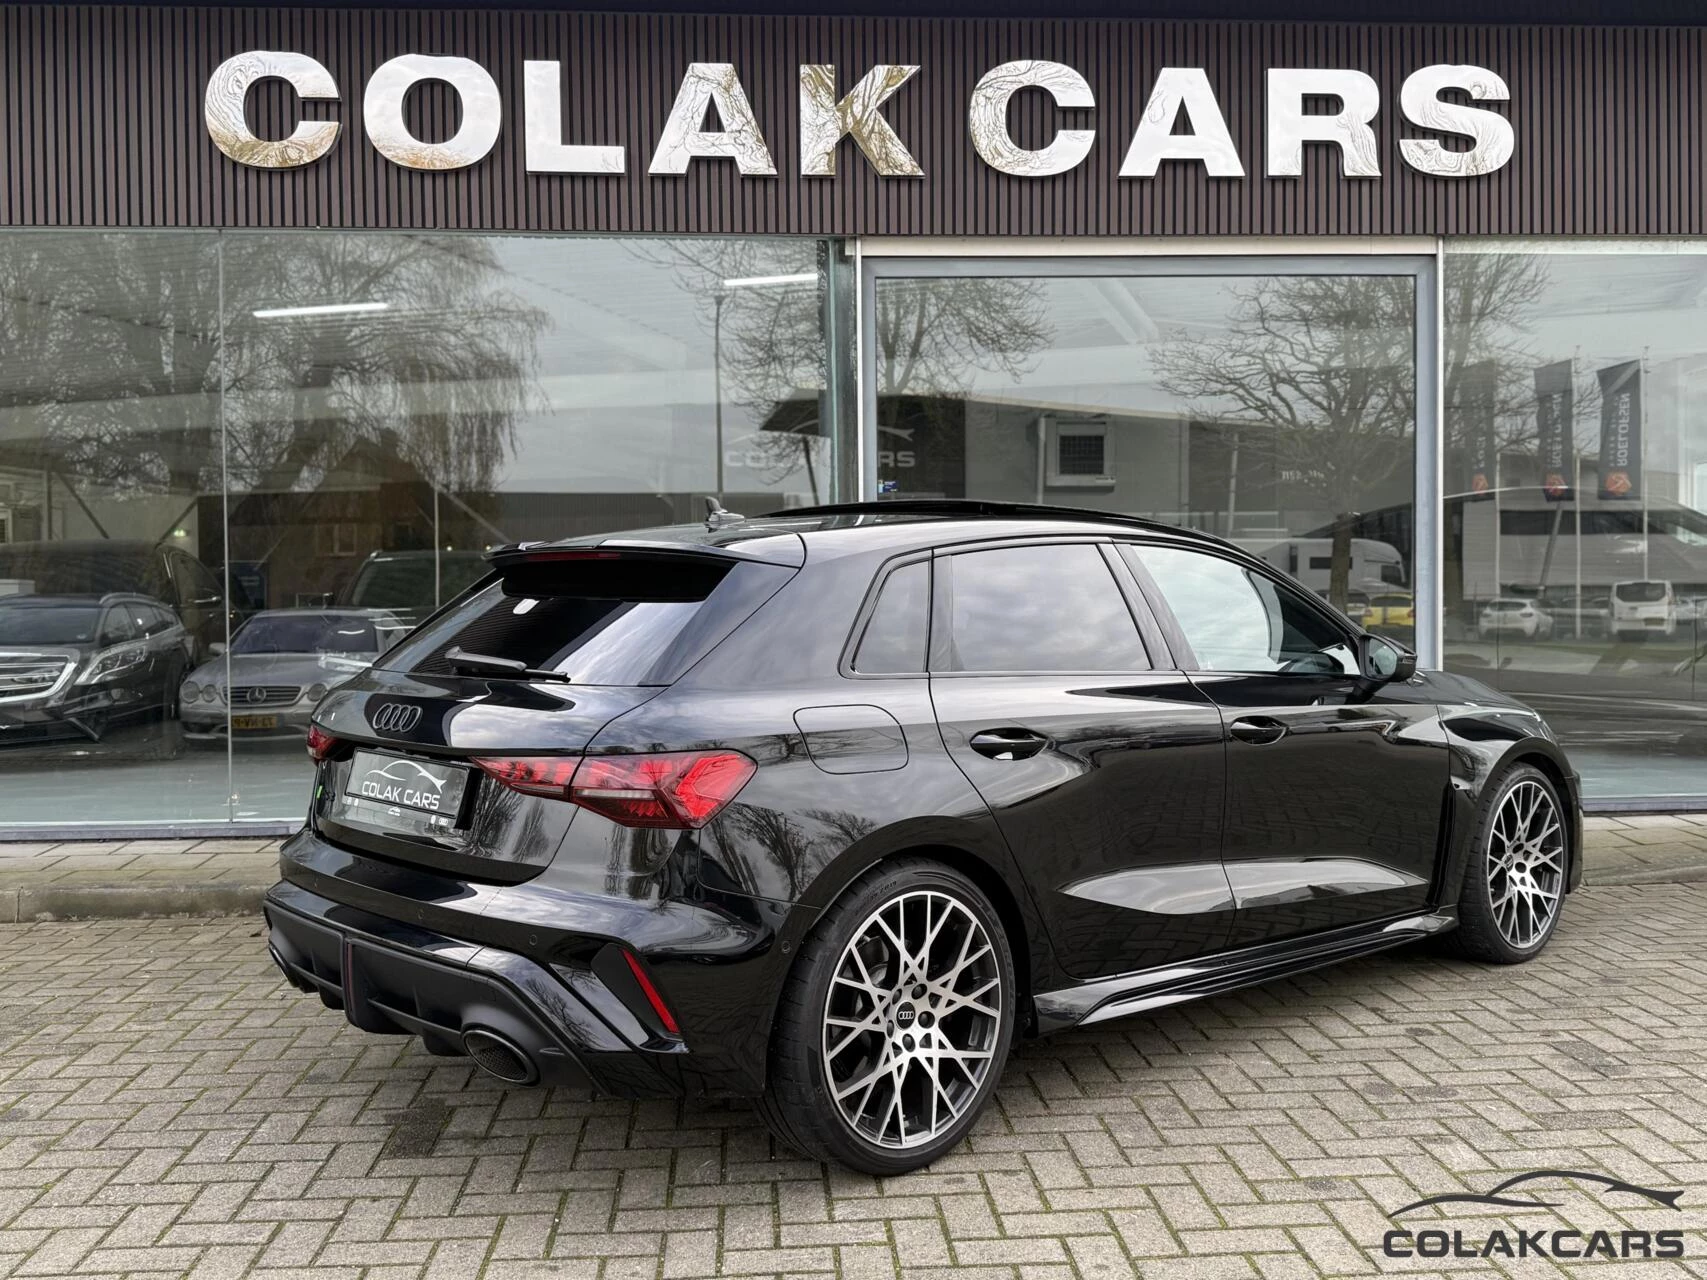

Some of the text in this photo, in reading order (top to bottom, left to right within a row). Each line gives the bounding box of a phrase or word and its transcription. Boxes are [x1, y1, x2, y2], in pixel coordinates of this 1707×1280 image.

[205, 50, 1516, 178] COLAK CARS
[361, 781, 441, 810] COLAK CARS
